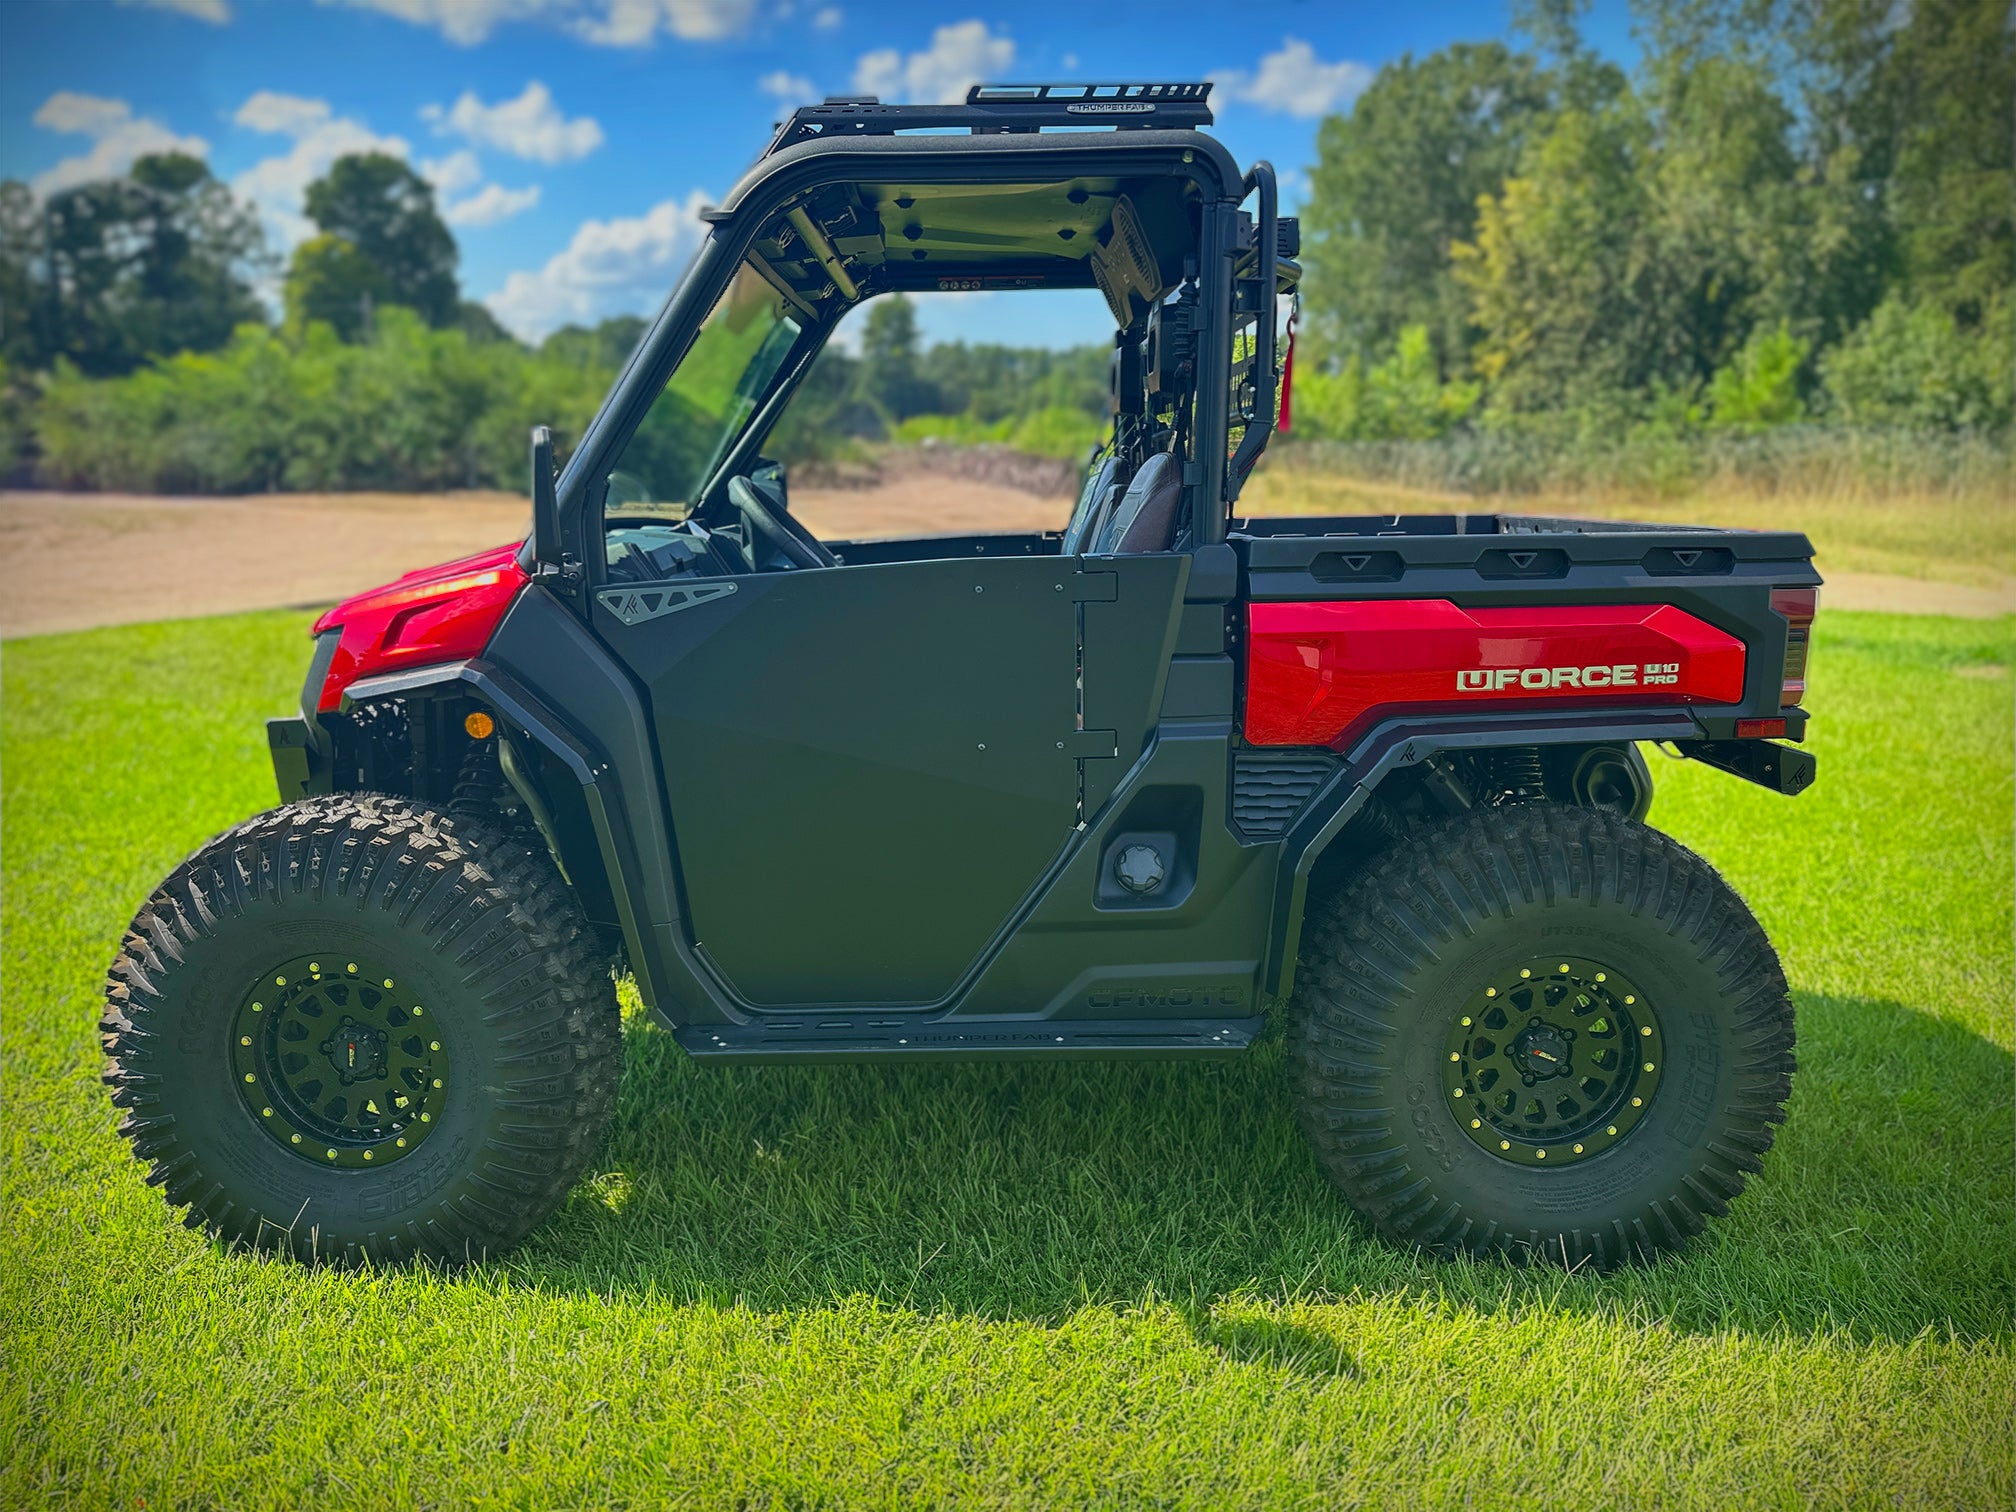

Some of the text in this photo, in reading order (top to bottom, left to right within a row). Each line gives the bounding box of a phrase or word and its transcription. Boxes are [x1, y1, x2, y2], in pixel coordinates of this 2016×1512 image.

[1077, 103, 1146, 111] THUMPER FAB
[1456, 663, 1680, 692] UFORCE U10
[1643, 675, 1679, 685] PRO
[1087, 986, 1244, 1009] CFMOTO
[914, 1033, 1050, 1042] THUMPER FAB
